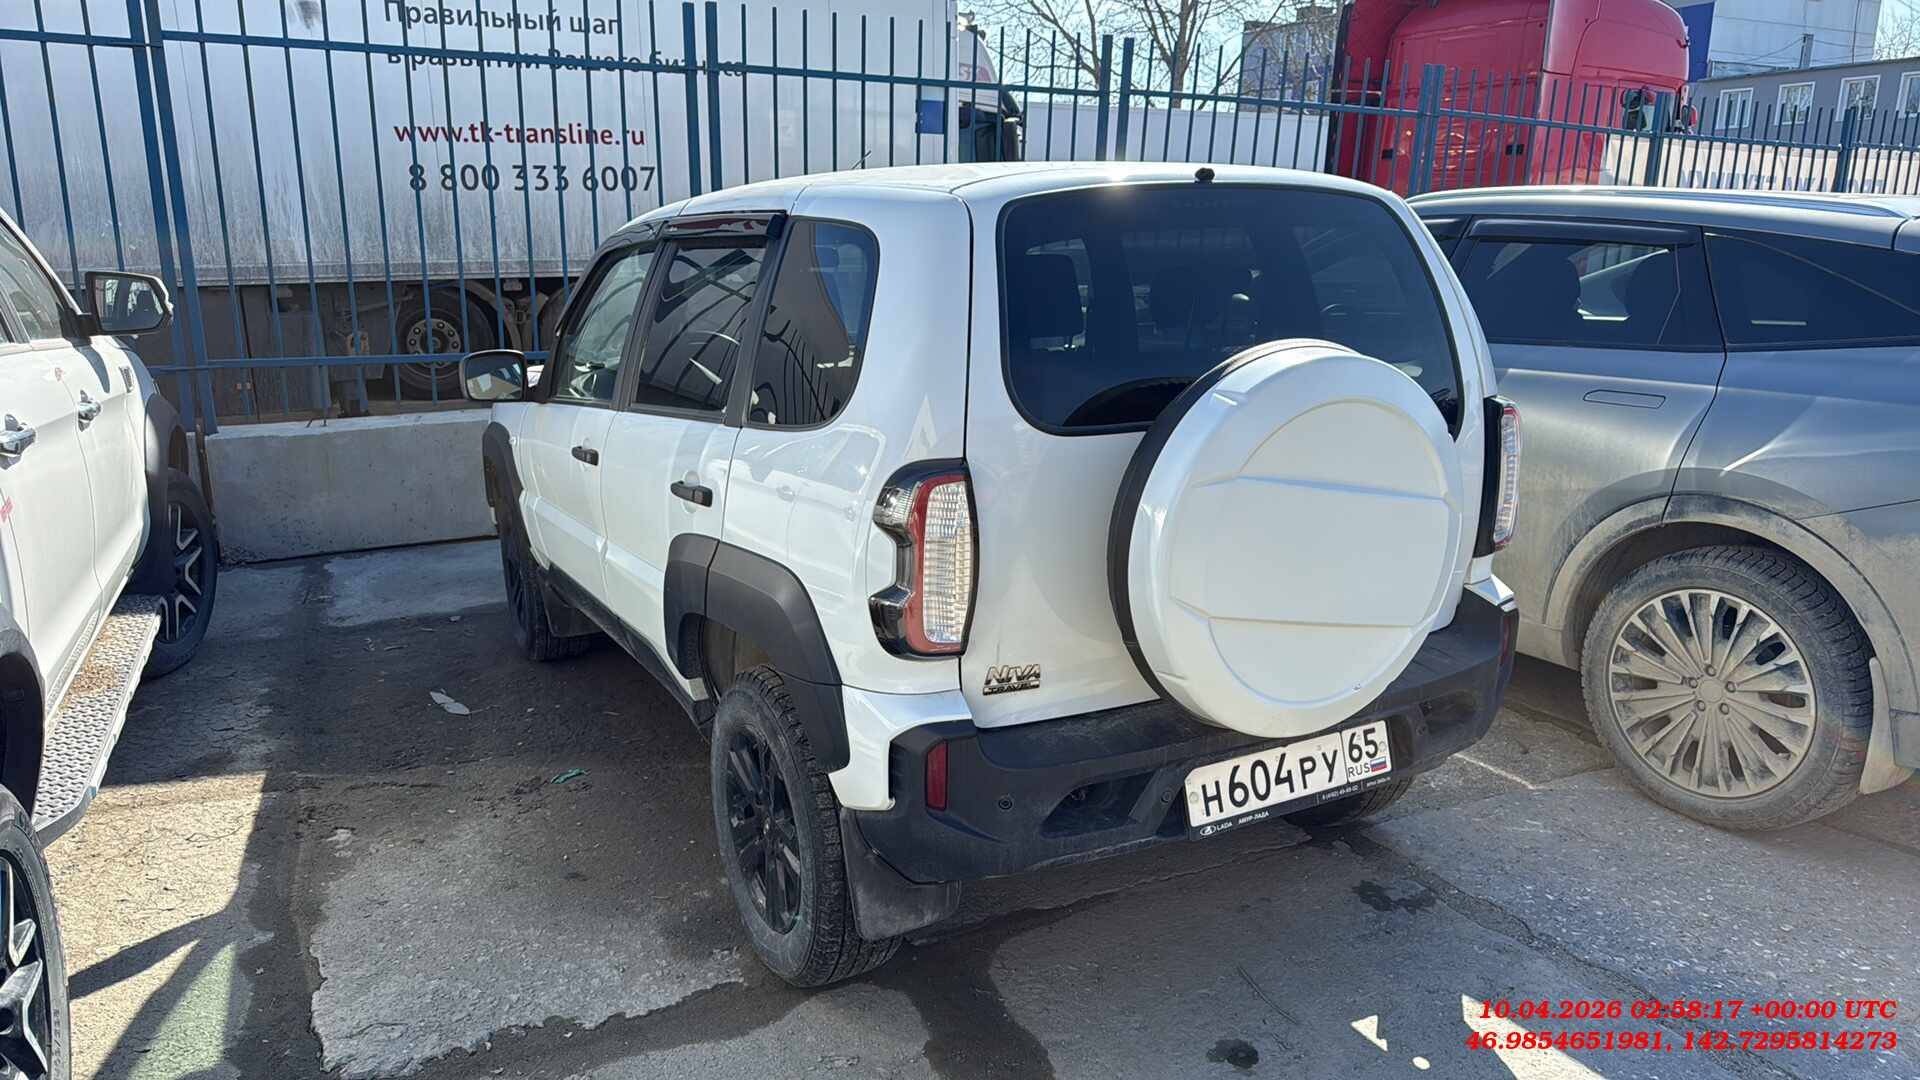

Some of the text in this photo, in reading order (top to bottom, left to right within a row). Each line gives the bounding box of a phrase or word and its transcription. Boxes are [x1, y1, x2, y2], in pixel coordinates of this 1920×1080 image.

[385, 0, 619, 35] Правильный шаг
[408, 163, 656, 192] 8 800 333 6007
[984, 664, 1040, 685] NIVA
[1348, 728, 1378, 763] 65
[1348, 761, 1370, 778] RUS
[1216, 821, 1233, 831] LADA
